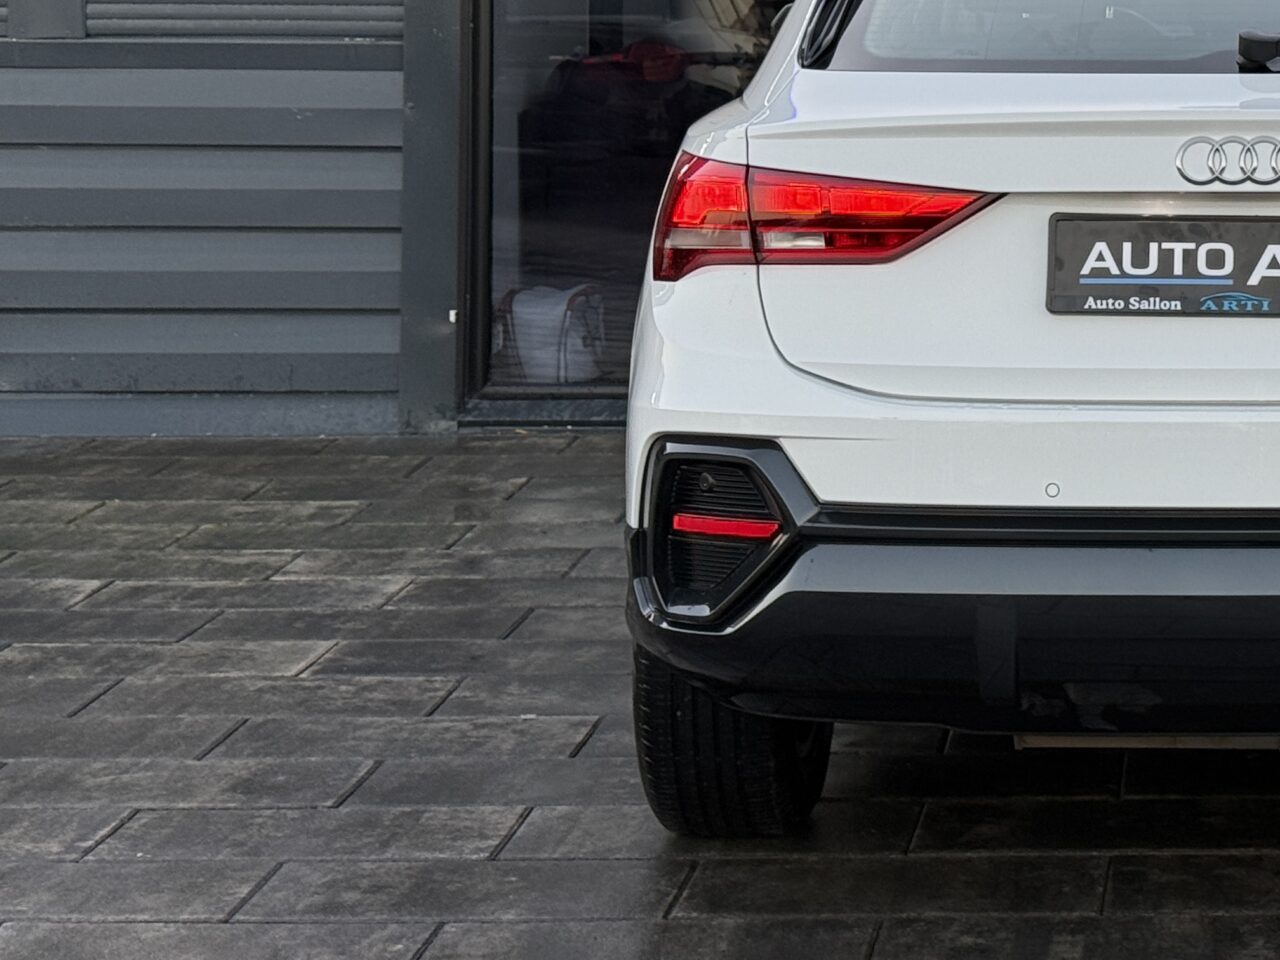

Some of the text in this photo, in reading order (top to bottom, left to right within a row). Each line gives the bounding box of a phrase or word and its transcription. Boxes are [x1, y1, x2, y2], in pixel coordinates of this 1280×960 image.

[1079, 241, 1235, 277] AUTO
[1083, 296, 1125, 310] Auto
[1128, 297, 1182, 311] Sallon
[1199, 300, 1271, 311] ARTI
